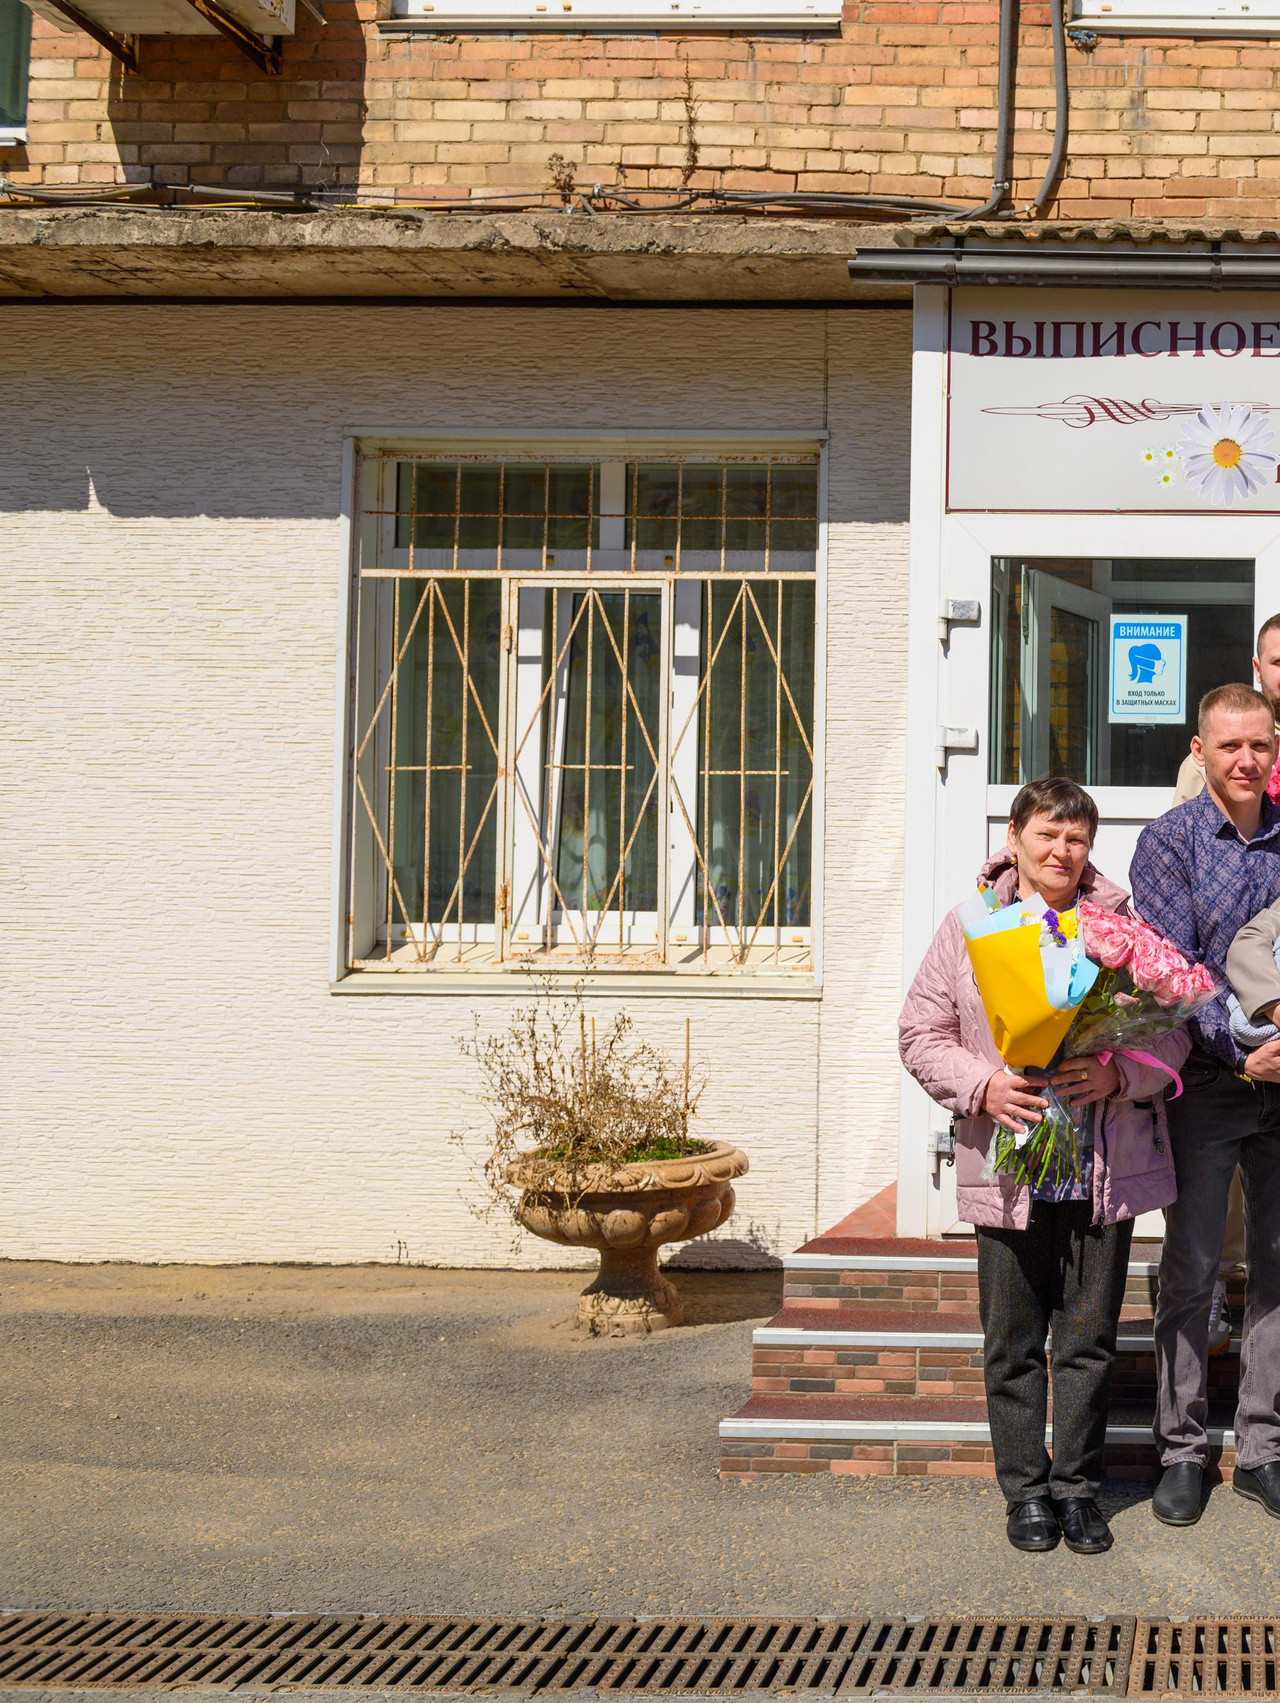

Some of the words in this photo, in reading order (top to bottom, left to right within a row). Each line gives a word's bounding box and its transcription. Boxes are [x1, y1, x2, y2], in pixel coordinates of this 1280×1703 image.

[1119, 625, 1176, 637] ВНИМАНИЕ
[1127, 690, 1142, 698] ВХОД
[1121, 699, 1153, 707] ЗАЩИТНЫХ
